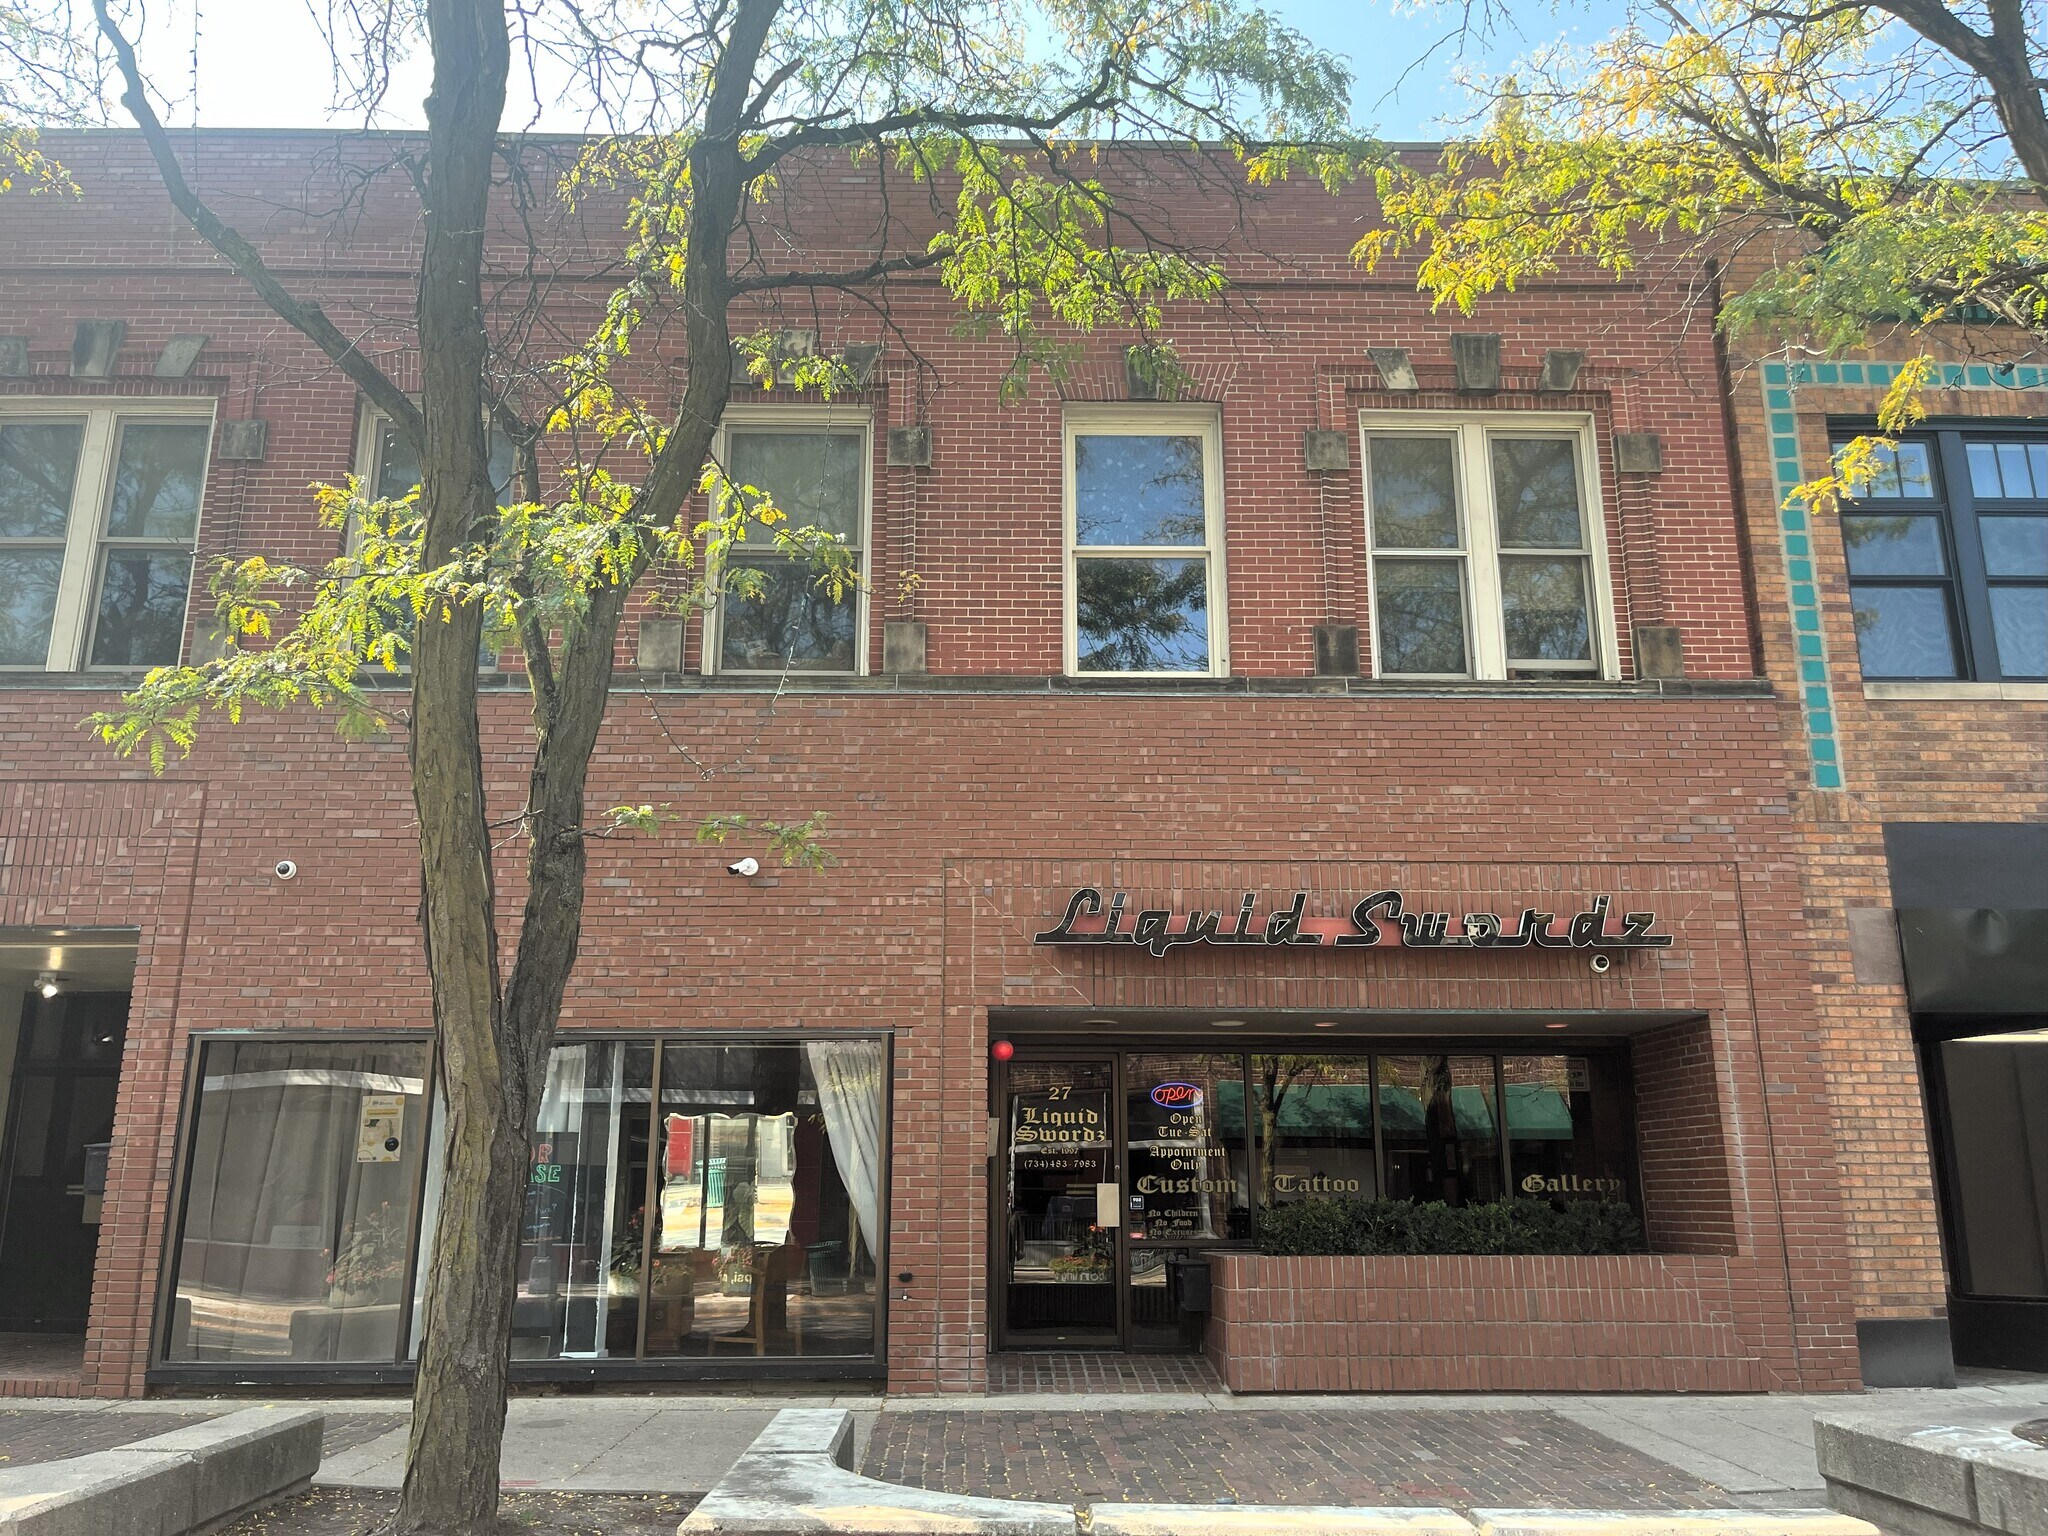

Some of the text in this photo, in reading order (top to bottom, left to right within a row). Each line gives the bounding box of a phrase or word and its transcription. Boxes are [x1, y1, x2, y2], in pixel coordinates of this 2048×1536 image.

[1033, 887, 1674, 958] Liquid Swordz
[1048, 1086, 1072, 1101] 27
[1021, 1107, 1099, 1127] Liquid
[1170, 1112, 1202, 1126] Open
[1014, 1125, 1106, 1145] Swordz
[1149, 1145, 1226, 1158] Appointment
[1170, 1158, 1202, 1171] Only
[1136, 1173, 1621, 1196] Custom Tattoo Gallery
[1147, 1209, 1199, 1218] No Children
[1154, 1218, 1193, 1227] No Food
[1149, 1228, 1162, 1236] No
